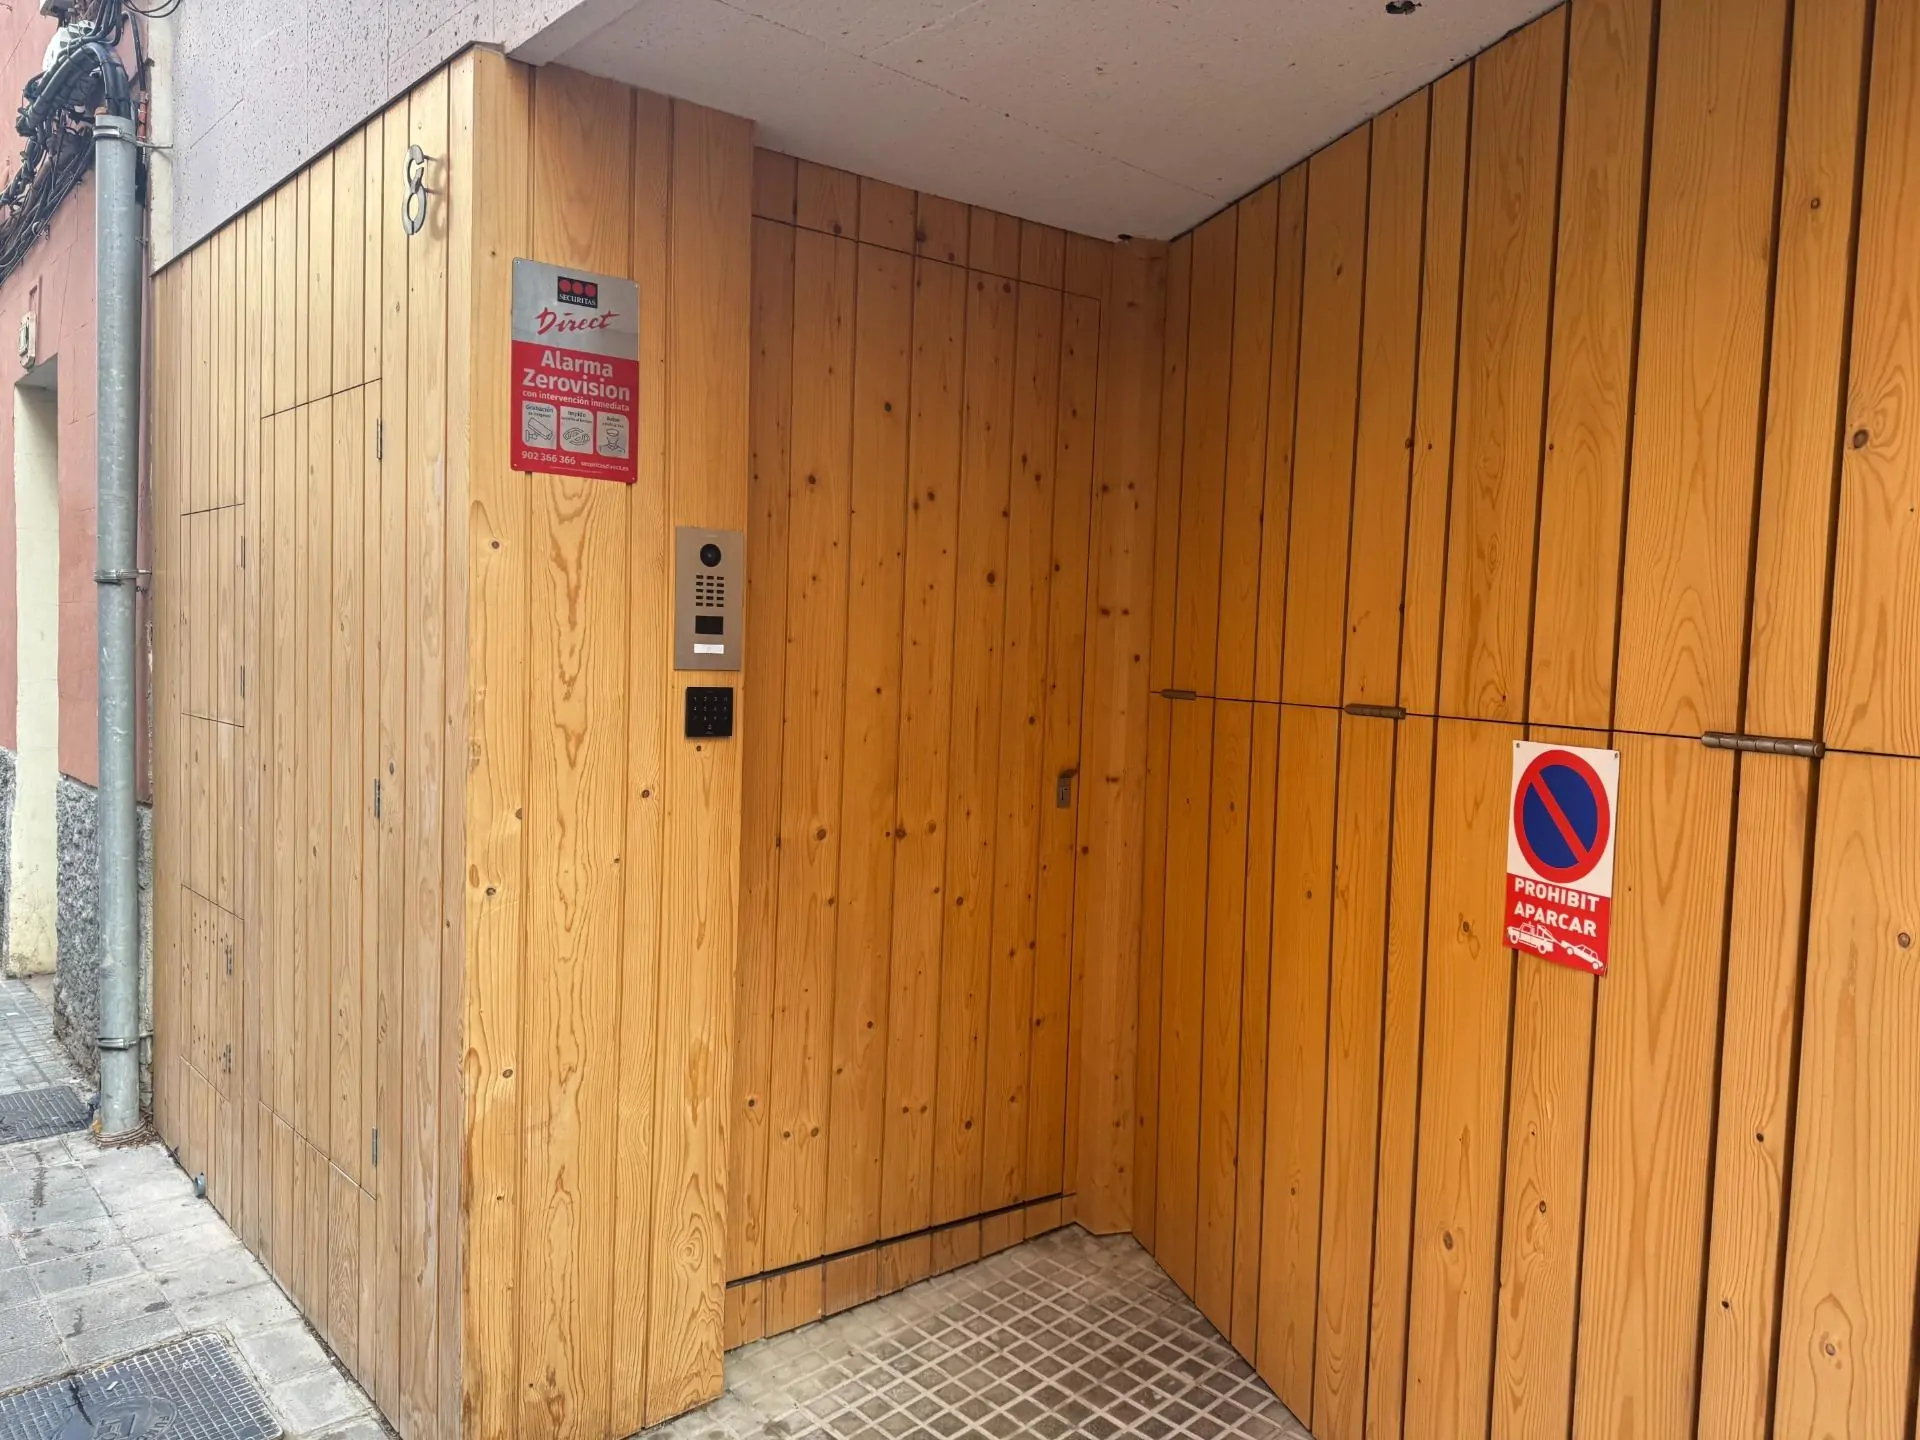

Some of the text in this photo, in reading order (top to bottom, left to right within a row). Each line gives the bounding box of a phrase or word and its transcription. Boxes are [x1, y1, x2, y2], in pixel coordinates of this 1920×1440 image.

[559, 293, 597, 306] SECURITAS
[535, 307, 620, 335] Direct
[541, 350, 613, 377] Alarma
[522, 368, 630, 401] Zerovision
[522, 389, 630, 412] con intervención inmediata
[522, 451, 576, 465] 902 366 366
[1515, 877, 1600, 912] PROHIBIT
[1514, 901, 1597, 937] APARCAR
